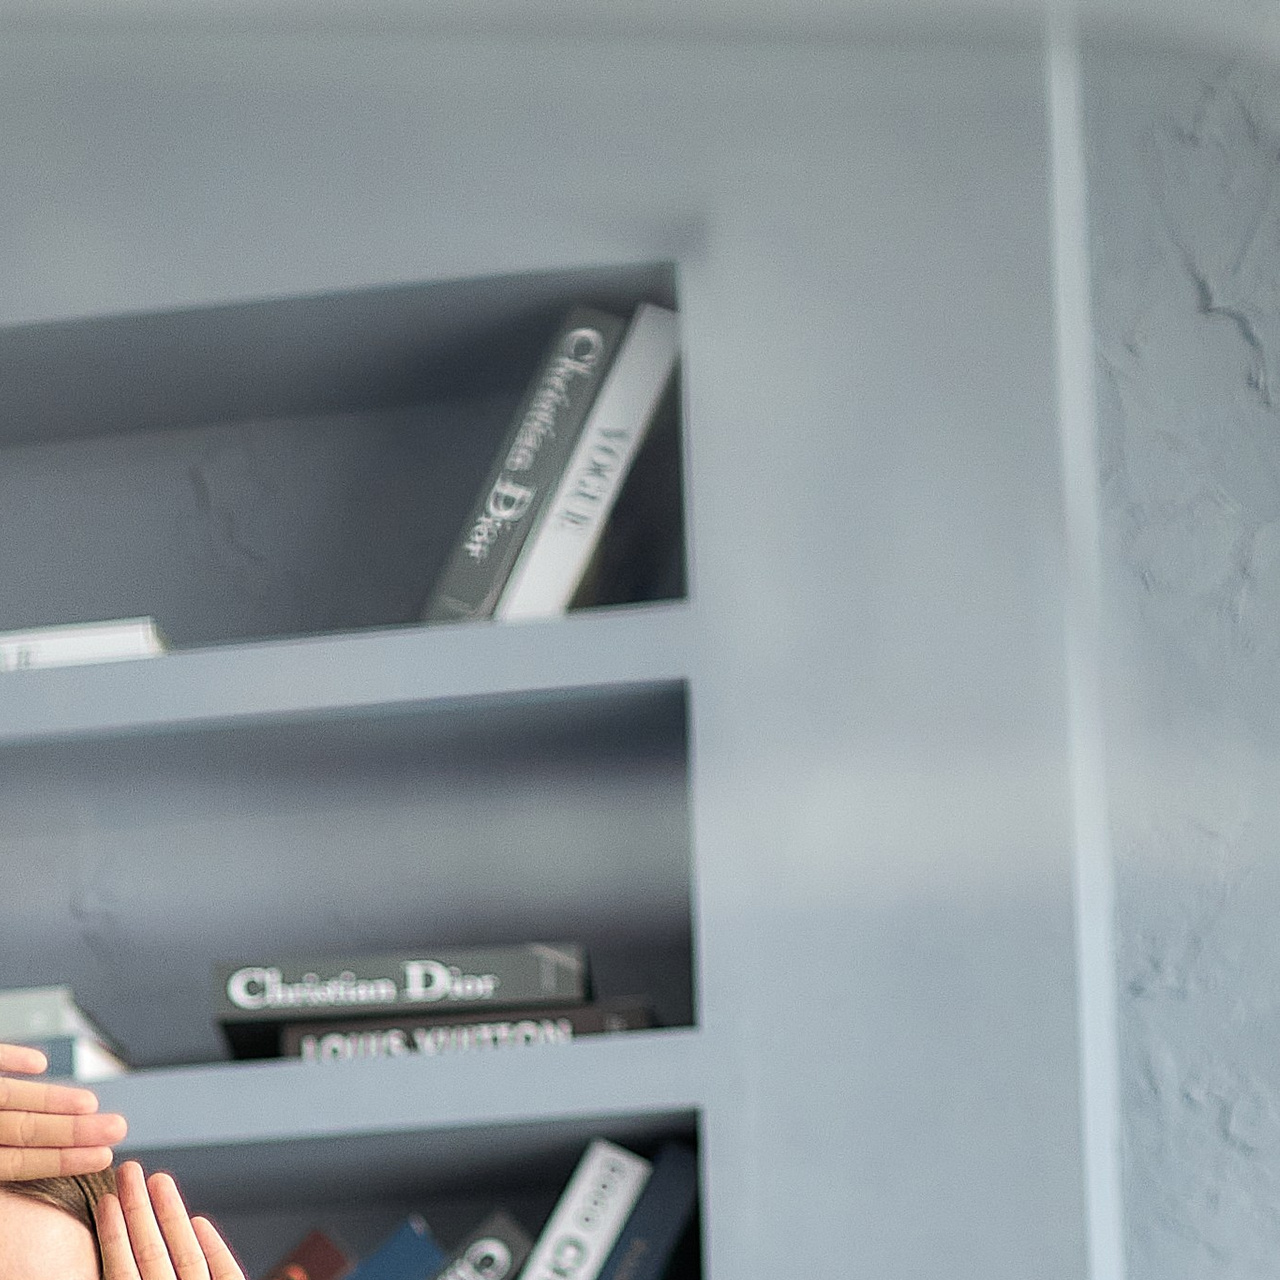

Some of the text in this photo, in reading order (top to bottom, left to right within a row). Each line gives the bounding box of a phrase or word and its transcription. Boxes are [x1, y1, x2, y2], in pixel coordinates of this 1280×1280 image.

[466, 327, 605, 561] Christian Dior
[558, 427, 628, 532] VOGUE
[226, 958, 501, 1010] Christian Dior
[300, 1016, 573, 1062] LOUIS VUITTON
